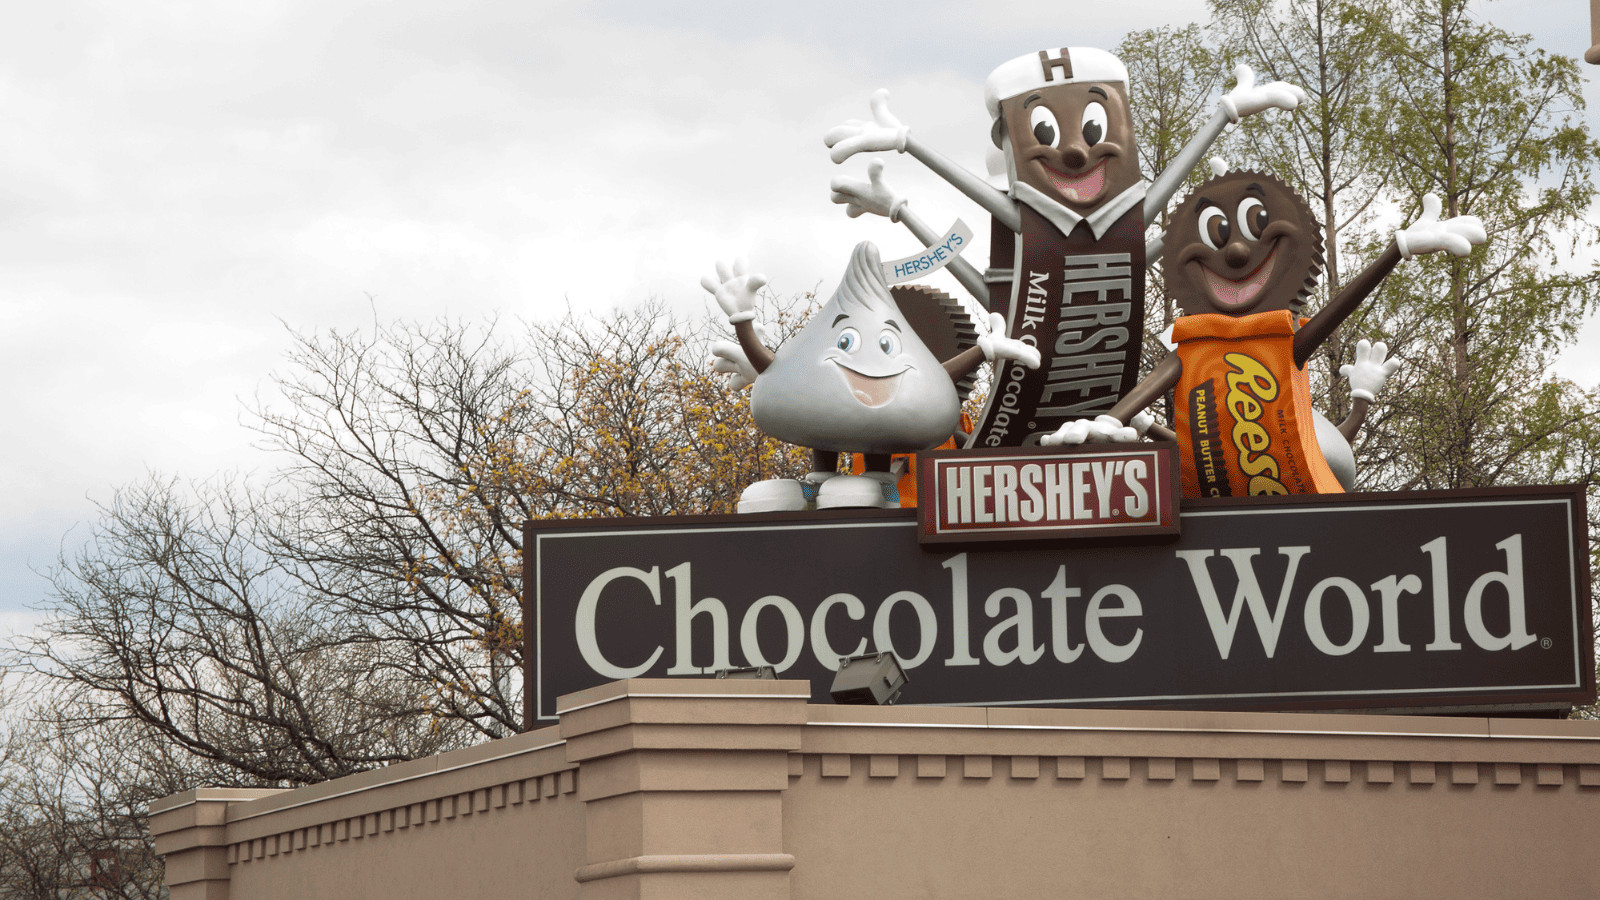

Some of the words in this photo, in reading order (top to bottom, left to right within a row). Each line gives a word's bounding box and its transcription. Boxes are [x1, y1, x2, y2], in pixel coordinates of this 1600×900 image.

[1039, 47, 1073, 82] H
[894, 233, 963, 278] HERSHEY'S
[1021, 270, 1049, 330] Milk
[1196, 389, 1209, 435] PEANUT
[1277, 409, 1288, 435] MILK
[1199, 440, 1216, 483] BUTTER
[946, 459, 1149, 524] HERSHEY'S
[575, 553, 1143, 679] Chocolate
[1176, 533, 1538, 660] World
